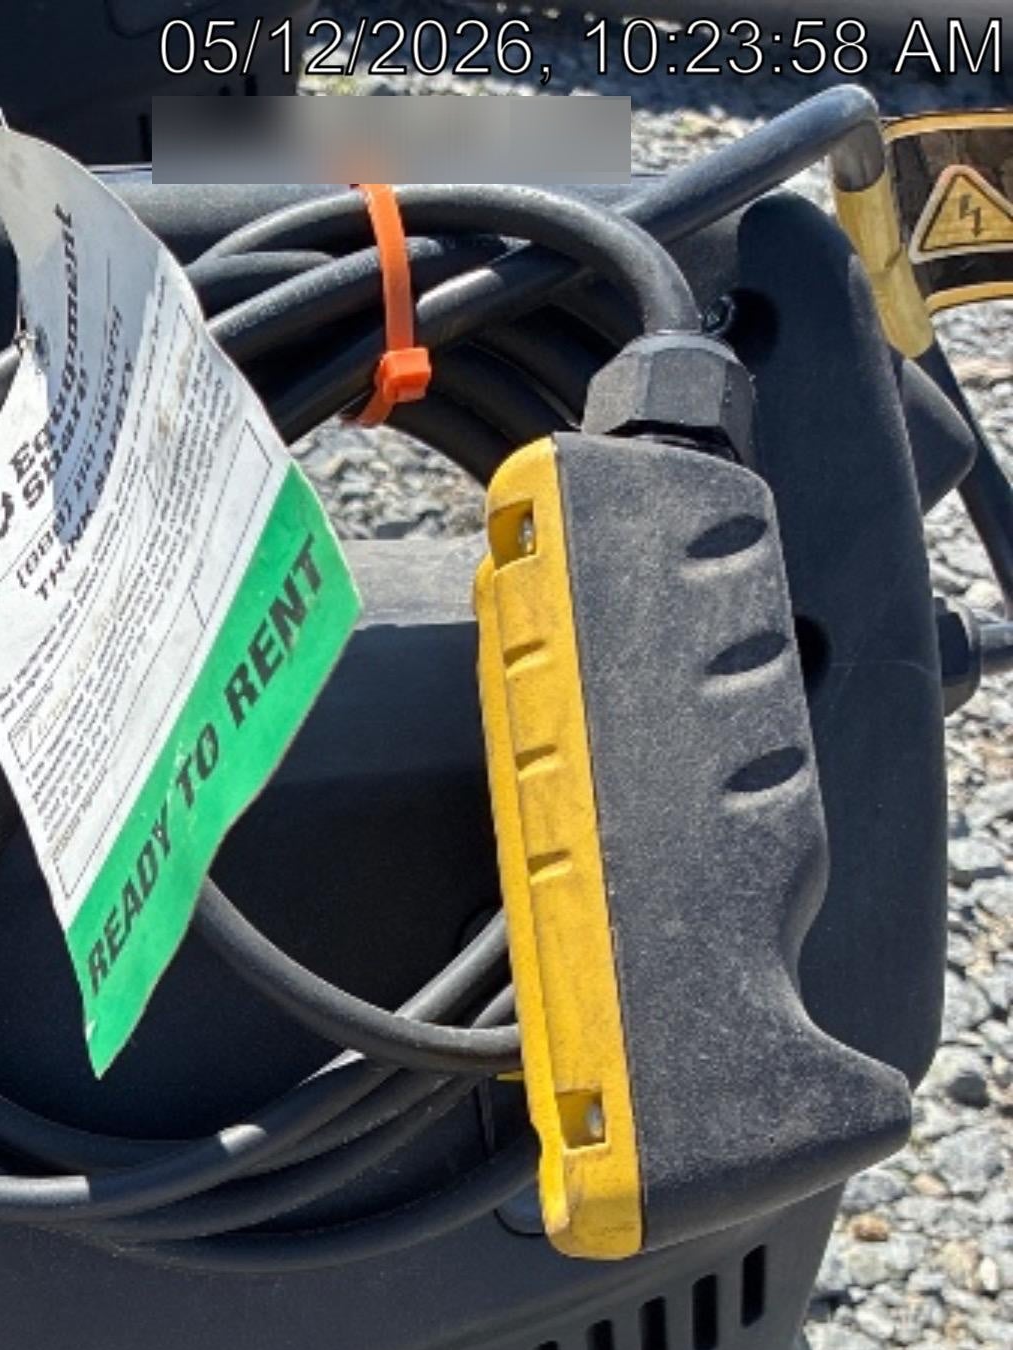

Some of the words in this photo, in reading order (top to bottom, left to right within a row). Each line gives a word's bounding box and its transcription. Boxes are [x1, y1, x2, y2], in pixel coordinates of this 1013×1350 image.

[9, 203, 78, 483] Equipment
[35, 501, 95, 601] THINK
[85, 800, 173, 996] READY
[175, 722, 221, 811] TO
[222, 533, 325, 729] RENT
